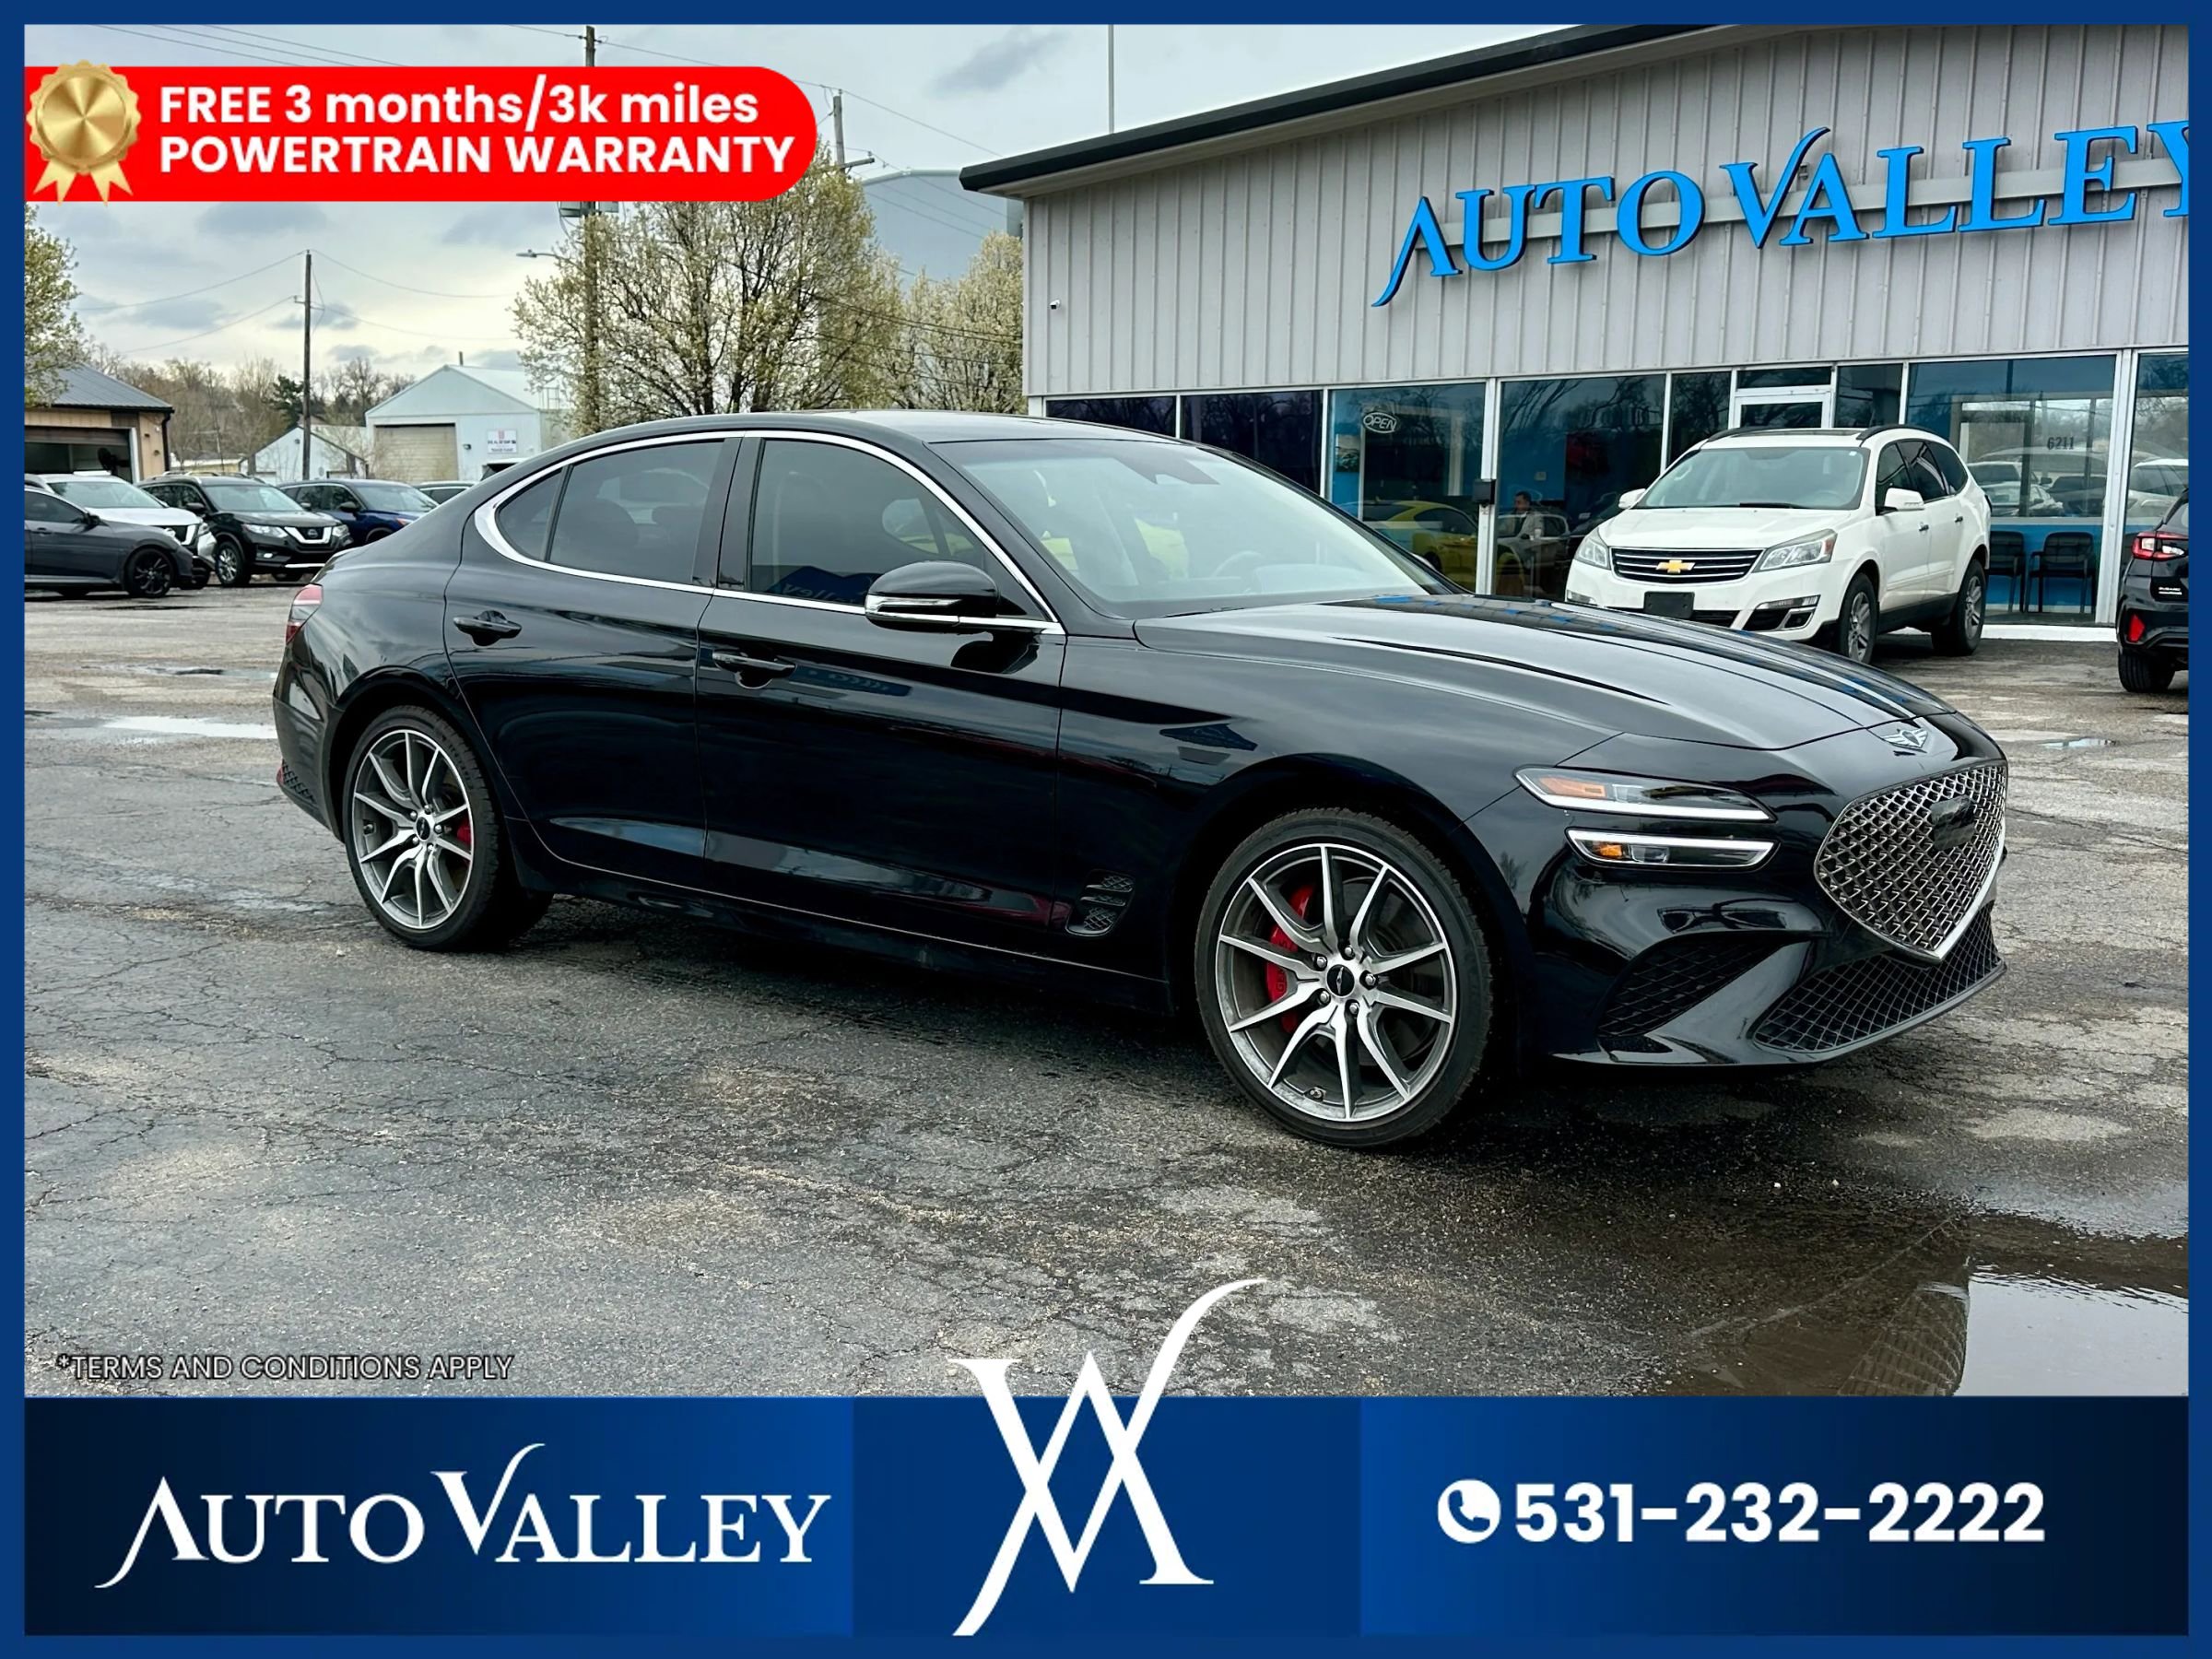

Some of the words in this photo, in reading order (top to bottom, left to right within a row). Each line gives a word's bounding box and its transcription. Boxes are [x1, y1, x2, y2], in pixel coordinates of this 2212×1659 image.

[1371, 171, 1706, 308] AUTO
[1363, 415, 1394, 431] OPEN
[2047, 436, 2074, 450] 6211
